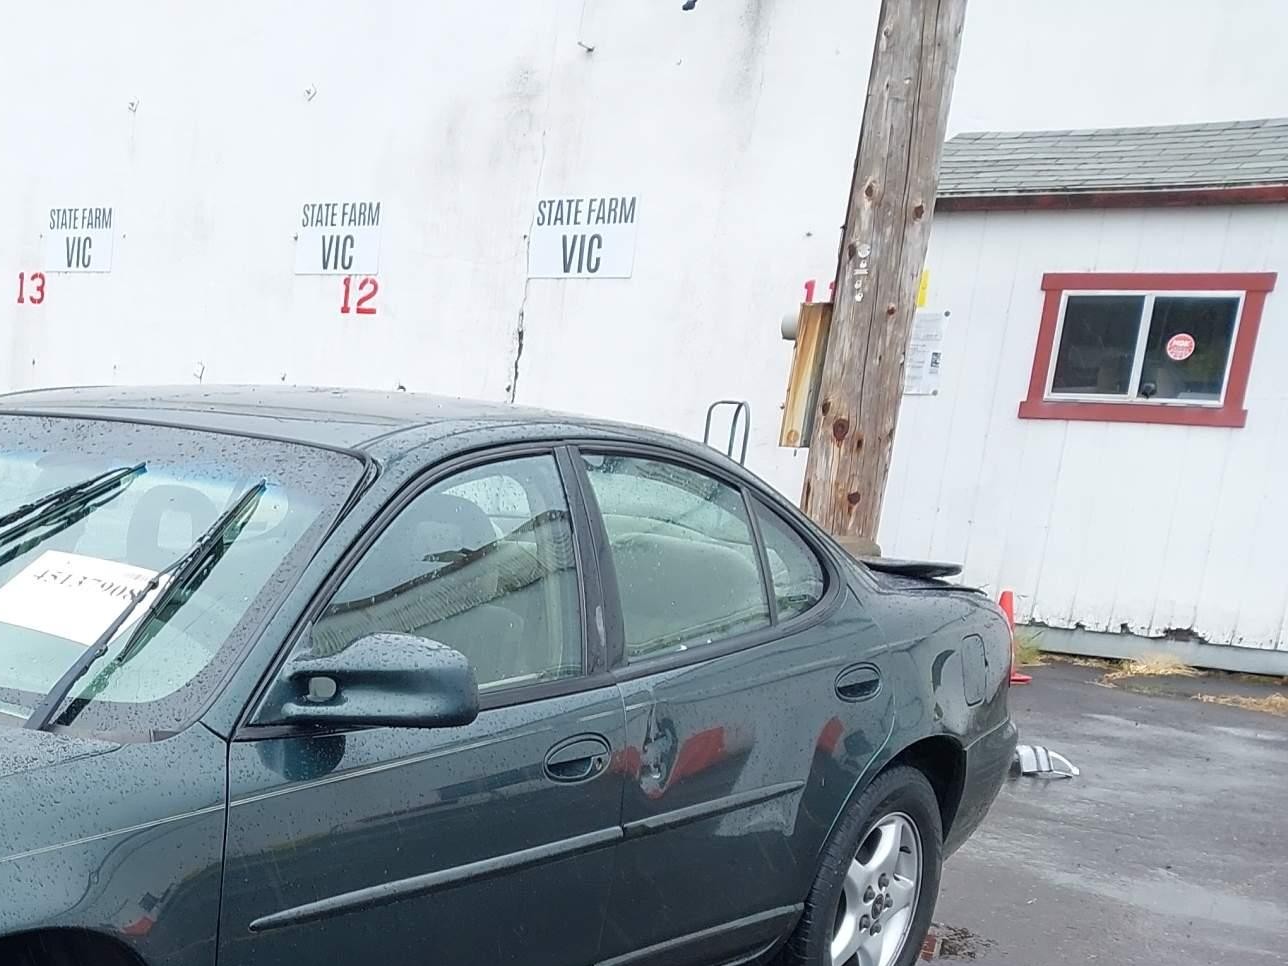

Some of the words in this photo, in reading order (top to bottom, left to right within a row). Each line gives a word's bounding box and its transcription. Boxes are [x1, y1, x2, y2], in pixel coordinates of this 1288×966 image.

[50, 208, 79, 231] STATE
[81, 207, 112, 230] FARM
[301, 202, 338, 228] STATE
[341, 201, 381, 227] FARM
[536, 198, 582, 227] STATE
[586, 196, 637, 225] FARM
[65, 236, 92, 269] VIC
[321, 234, 355, 271] VIC
[561, 233, 603, 274] VIC
[17, 272, 46, 304] 13
[340, 275, 379, 314] 12
